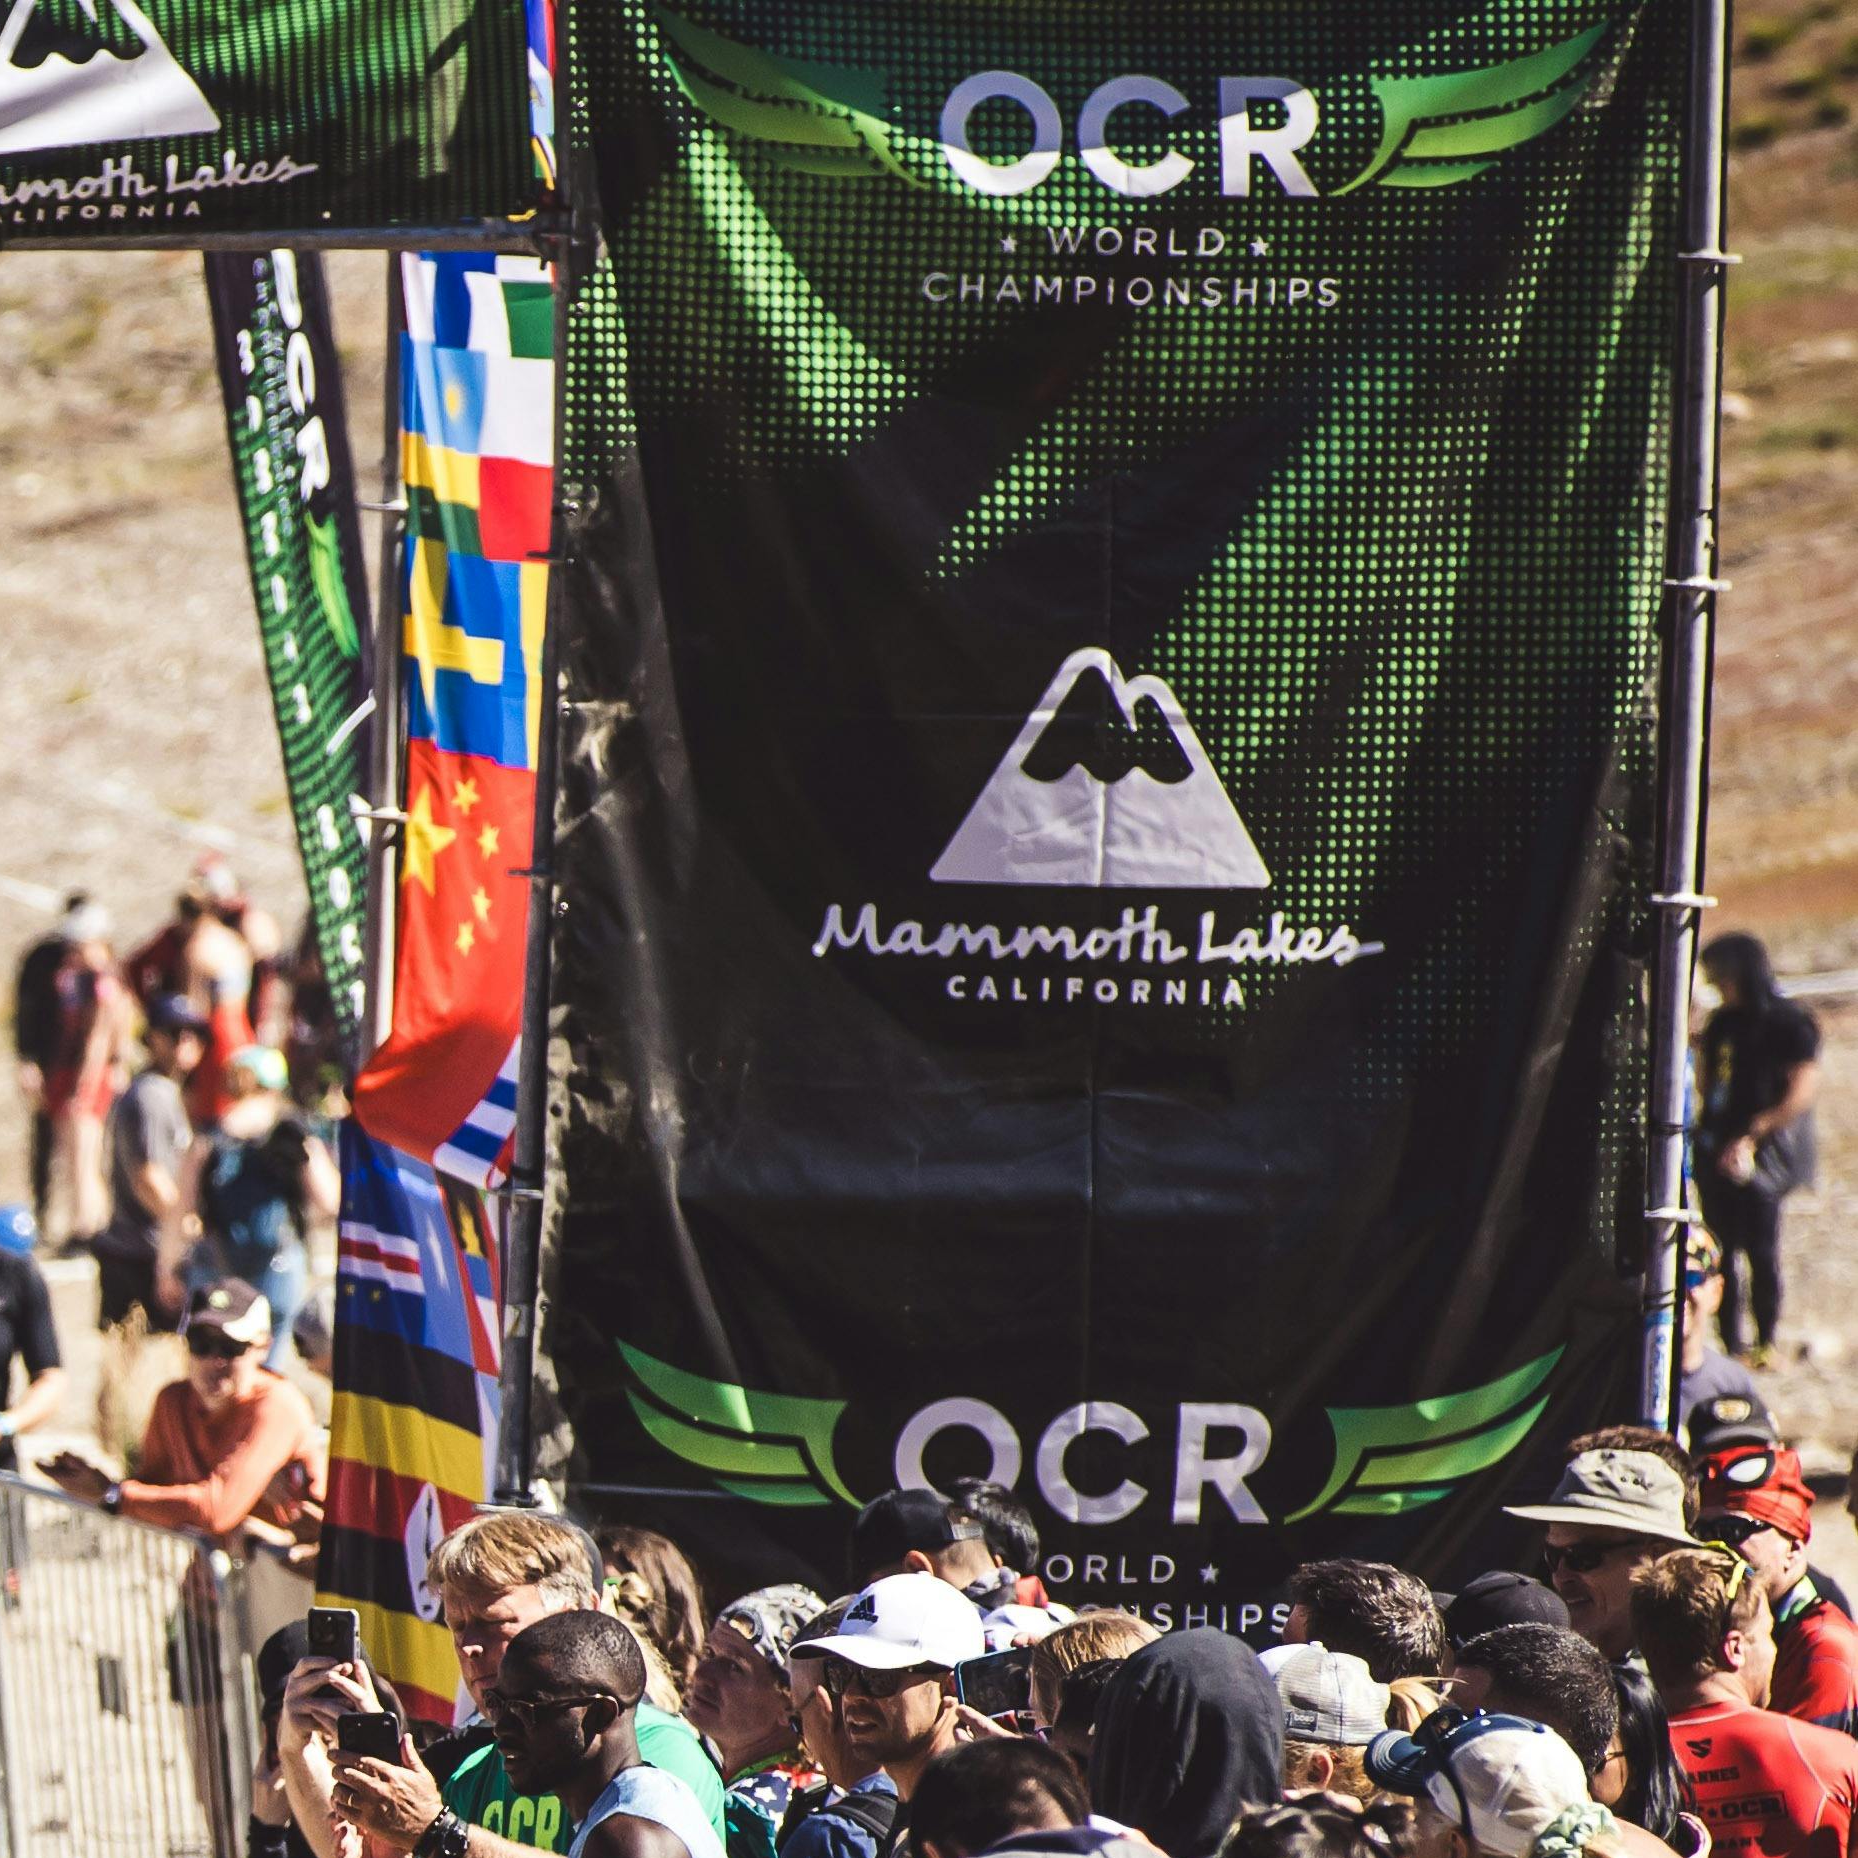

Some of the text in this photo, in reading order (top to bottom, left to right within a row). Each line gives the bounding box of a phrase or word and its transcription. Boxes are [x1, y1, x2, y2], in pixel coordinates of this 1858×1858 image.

[940, 70, 1321, 198] OCR
[165, 148, 318, 193] Lakes
[1047, 226, 1227, 258] WORLD
[922, 271, 1340, 308] CHAMPIONSHIPS
[812, 903, 1386, 967] Mammoth Lakes
[947, 974, 1246, 1006] CALIFORNIA
[894, 1396, 1272, 1525] OCR
[1044, 1553, 1176, 1585] ORLD
[1688, 1766, 1740, 1784] ANNES
